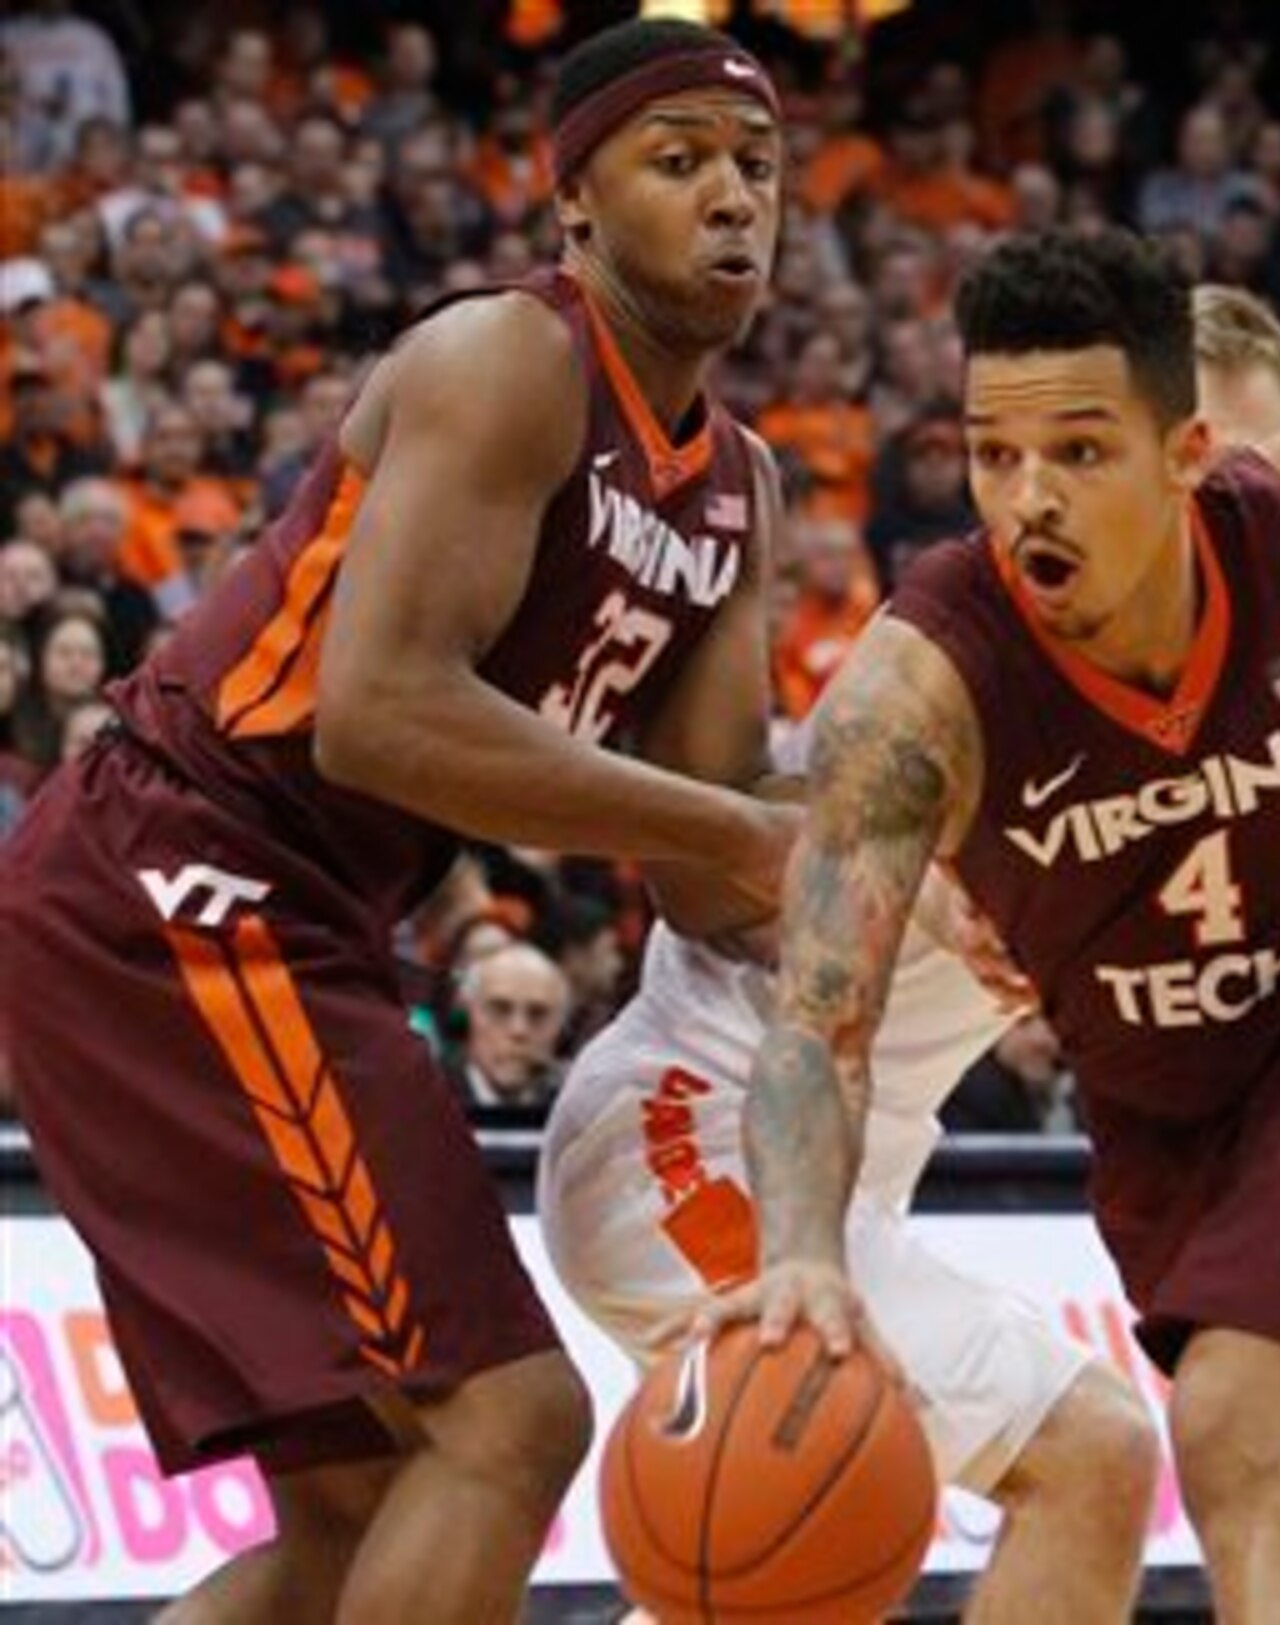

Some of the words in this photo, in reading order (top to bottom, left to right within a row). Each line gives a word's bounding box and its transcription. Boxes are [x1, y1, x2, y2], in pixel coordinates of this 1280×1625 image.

[540, 592, 673, 742] 32
[137, 863, 271, 927] VT
[1158, 828, 1246, 946] 4
